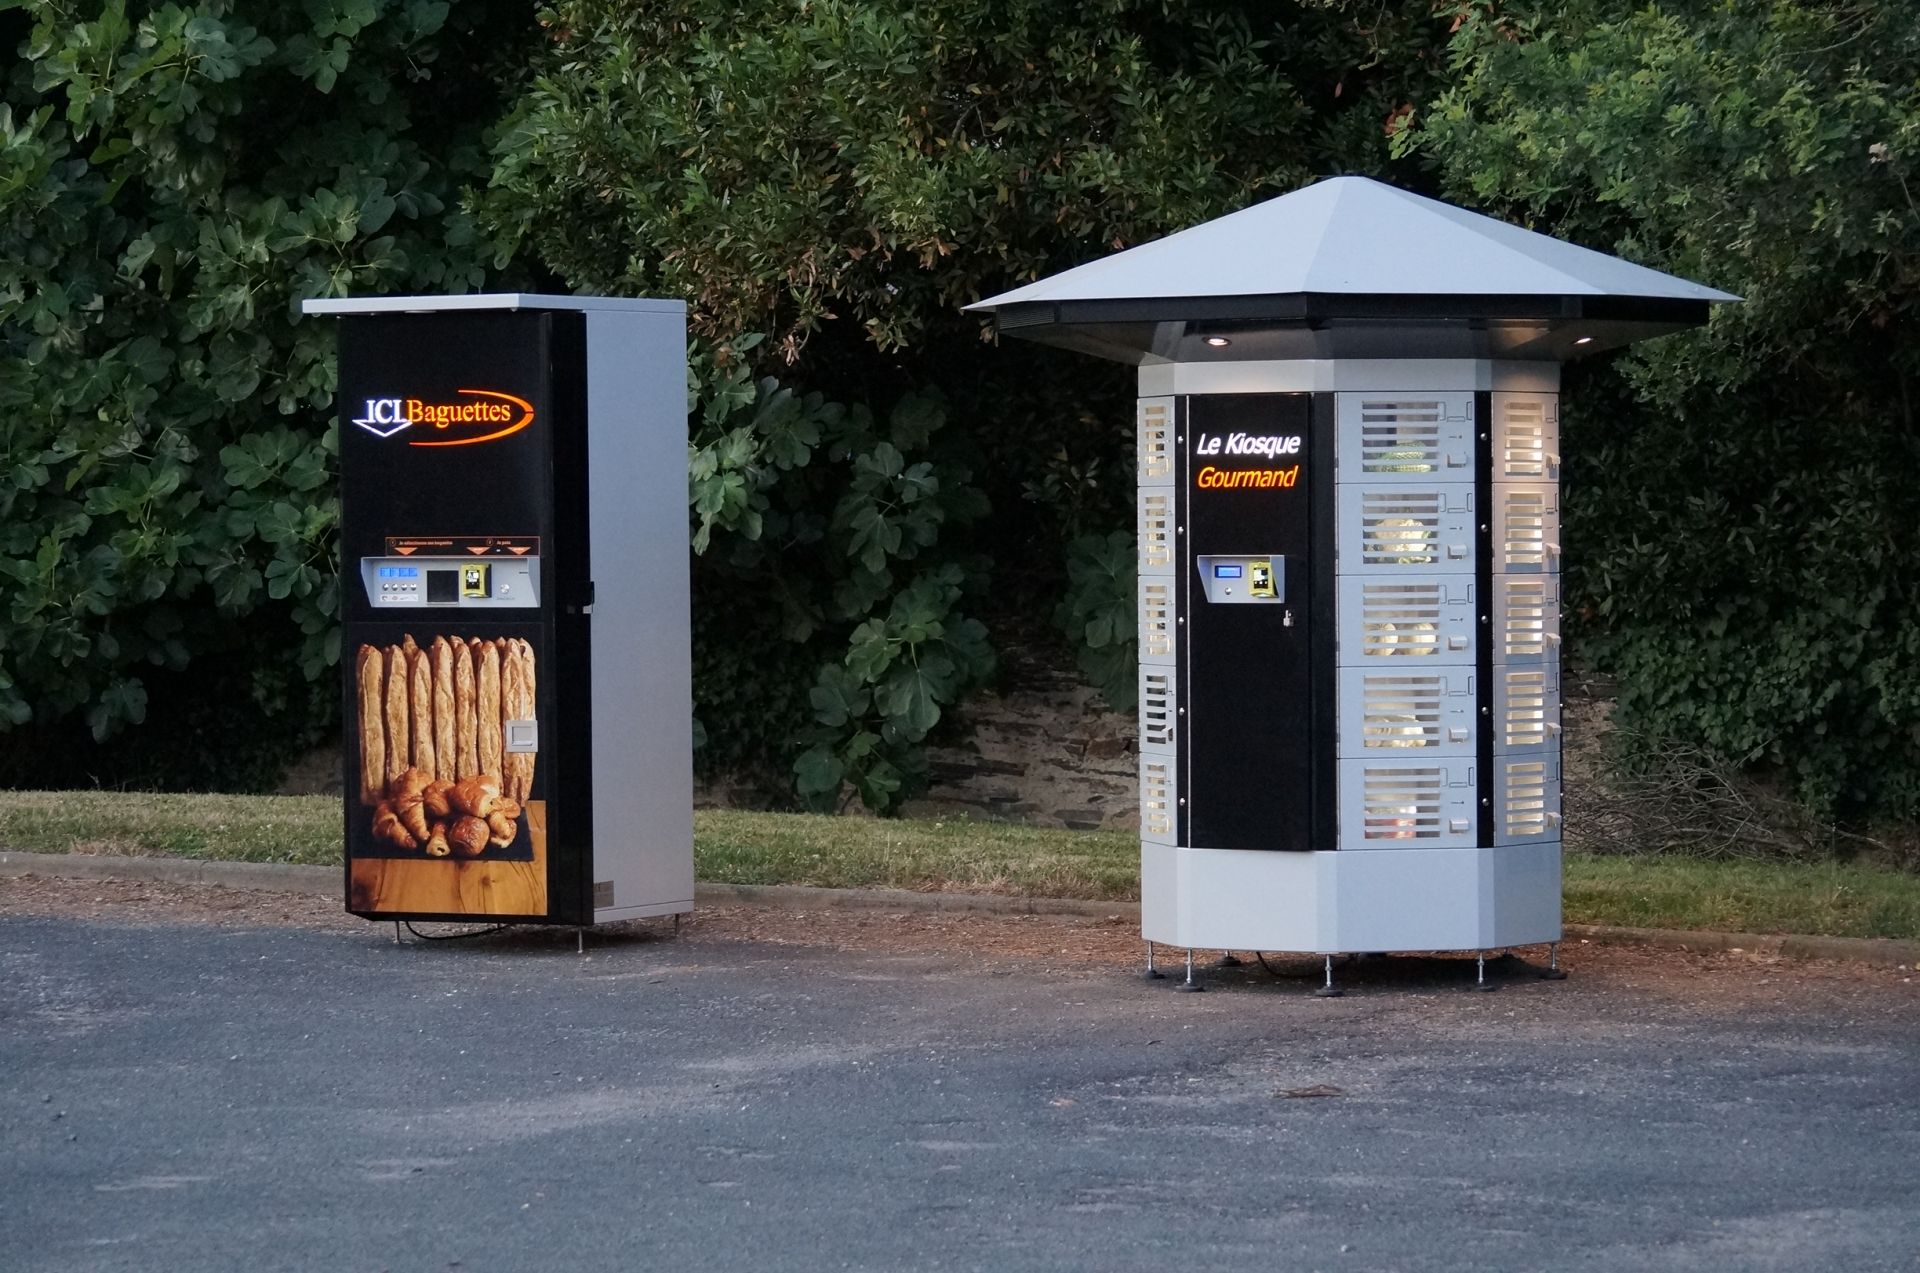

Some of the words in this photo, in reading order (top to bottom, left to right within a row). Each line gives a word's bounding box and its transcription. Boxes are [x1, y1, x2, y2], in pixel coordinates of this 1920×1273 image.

[366, 399, 403, 423] ICI
[406, 399, 511, 429] Baguettes
[1197, 432, 1222, 455] Le
[1224, 432, 1301, 459] Kiosque
[1198, 464, 1299, 488] Gourmand
